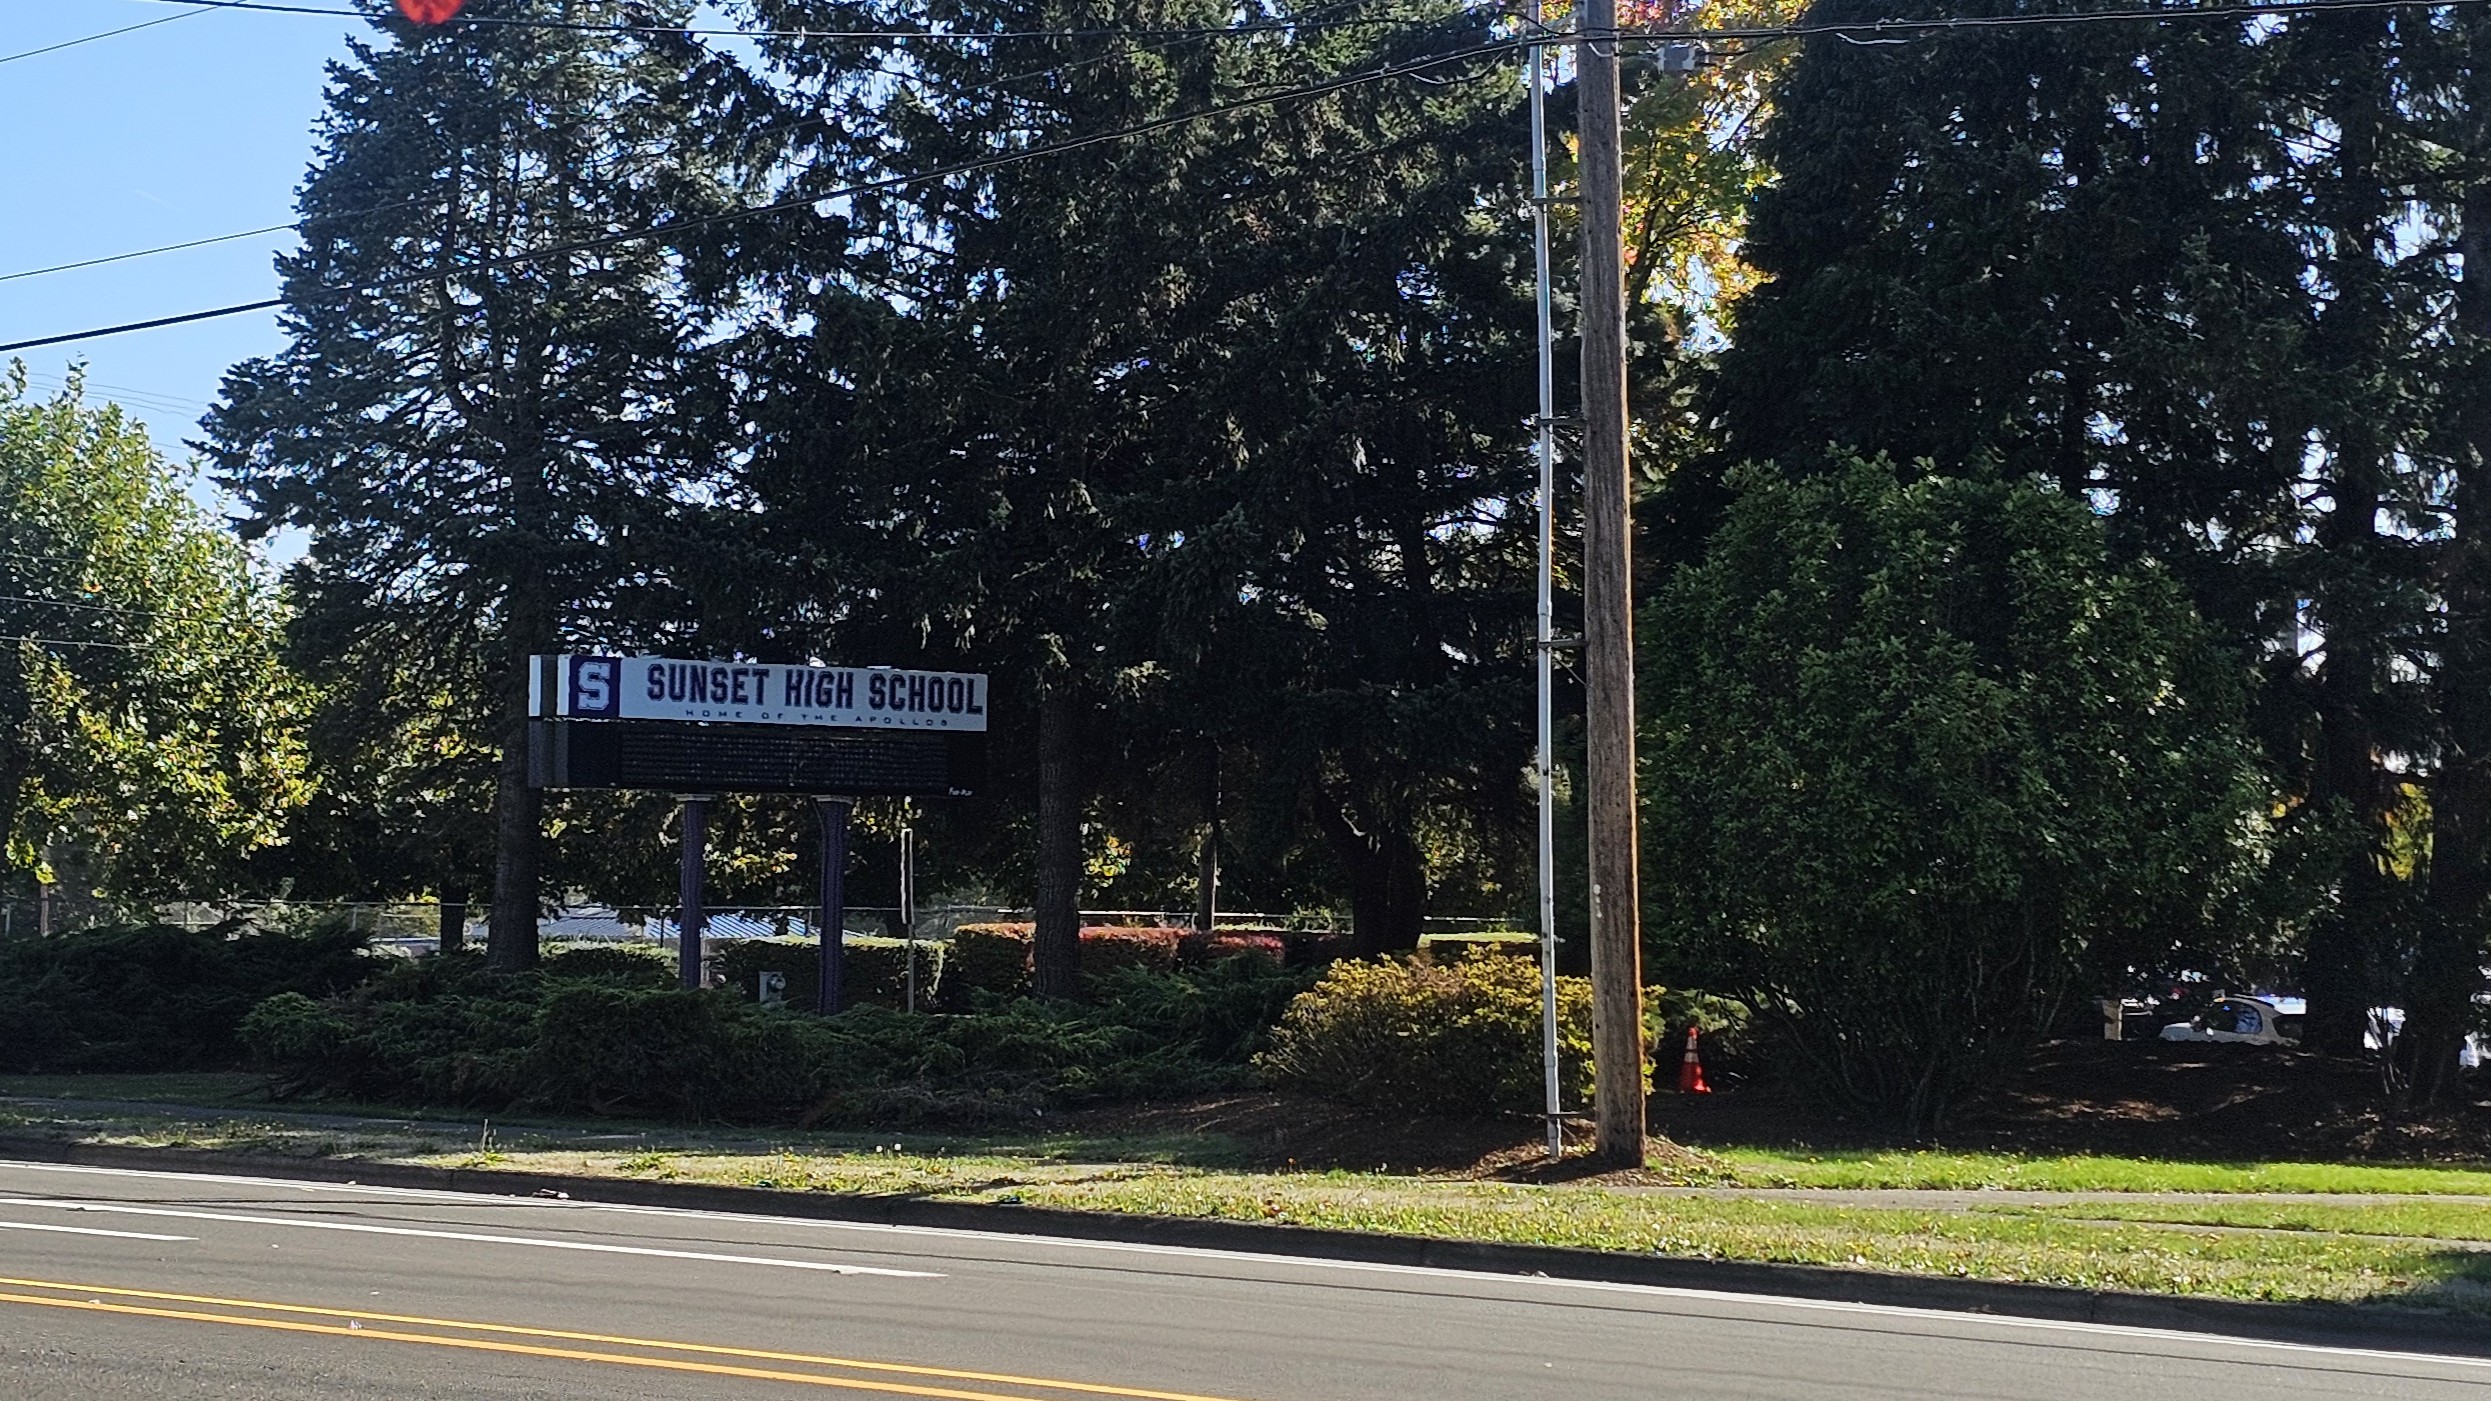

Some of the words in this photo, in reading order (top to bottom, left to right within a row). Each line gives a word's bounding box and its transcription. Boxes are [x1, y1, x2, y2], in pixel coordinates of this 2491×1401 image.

[578, 661, 611, 710] S
[647, 663, 770, 706] SUNSET
[784, 669, 854, 709] HIGH
[869, 673, 984, 715] SCHOOL
[685, 709, 743, 719] HOME
[761, 712, 784, 720] OF
[801, 713, 838, 722] THE
[855, 715, 948, 727] APOLLOS
